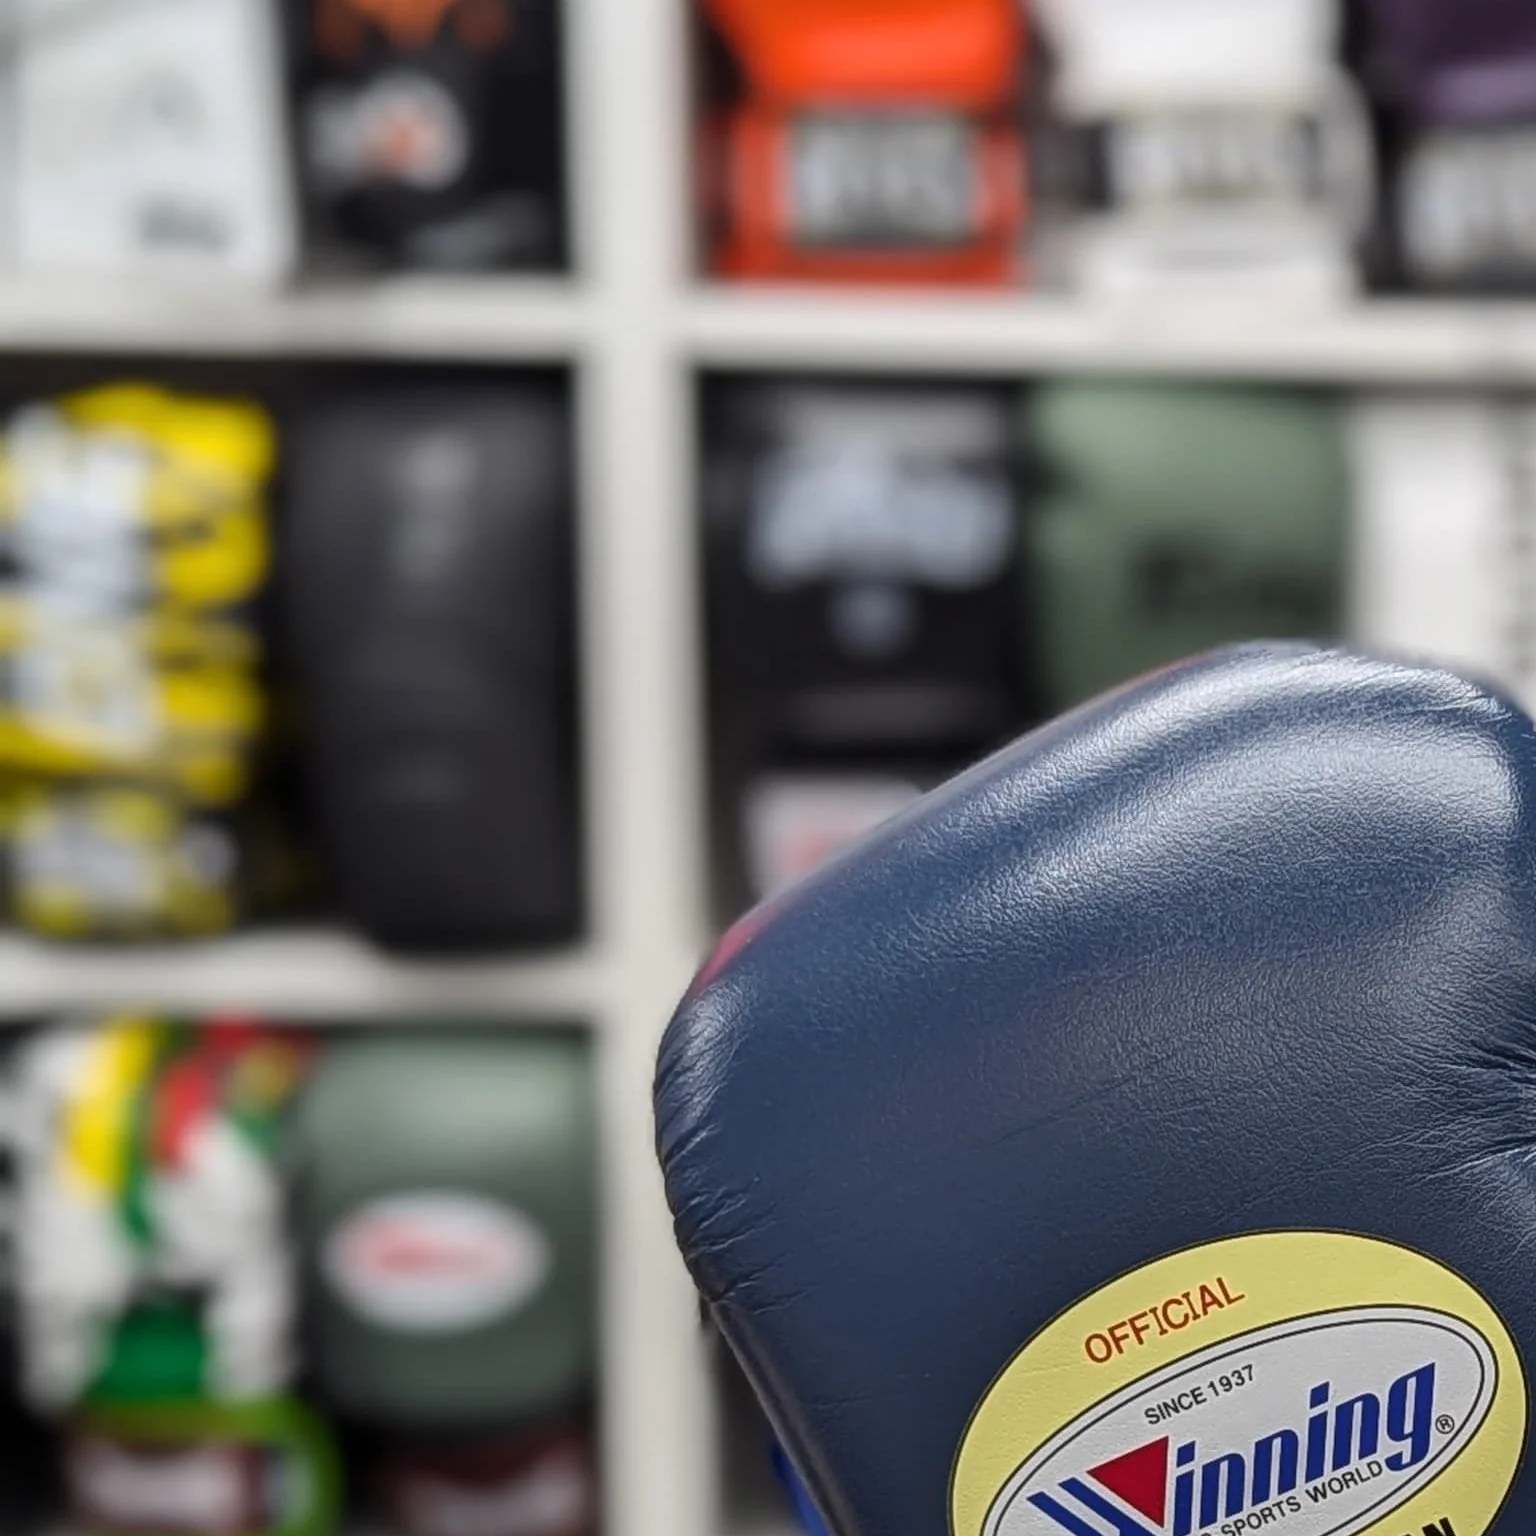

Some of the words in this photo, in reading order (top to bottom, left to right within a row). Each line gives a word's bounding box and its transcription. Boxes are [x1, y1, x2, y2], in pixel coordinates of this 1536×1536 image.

[1084, 1277, 1246, 1364] OFFICIAL
[1144, 1386, 1208, 1425] SINCE
[1207, 1363, 1254, 1397] 1937
[1305, 1459, 1383, 1503] WORLD
